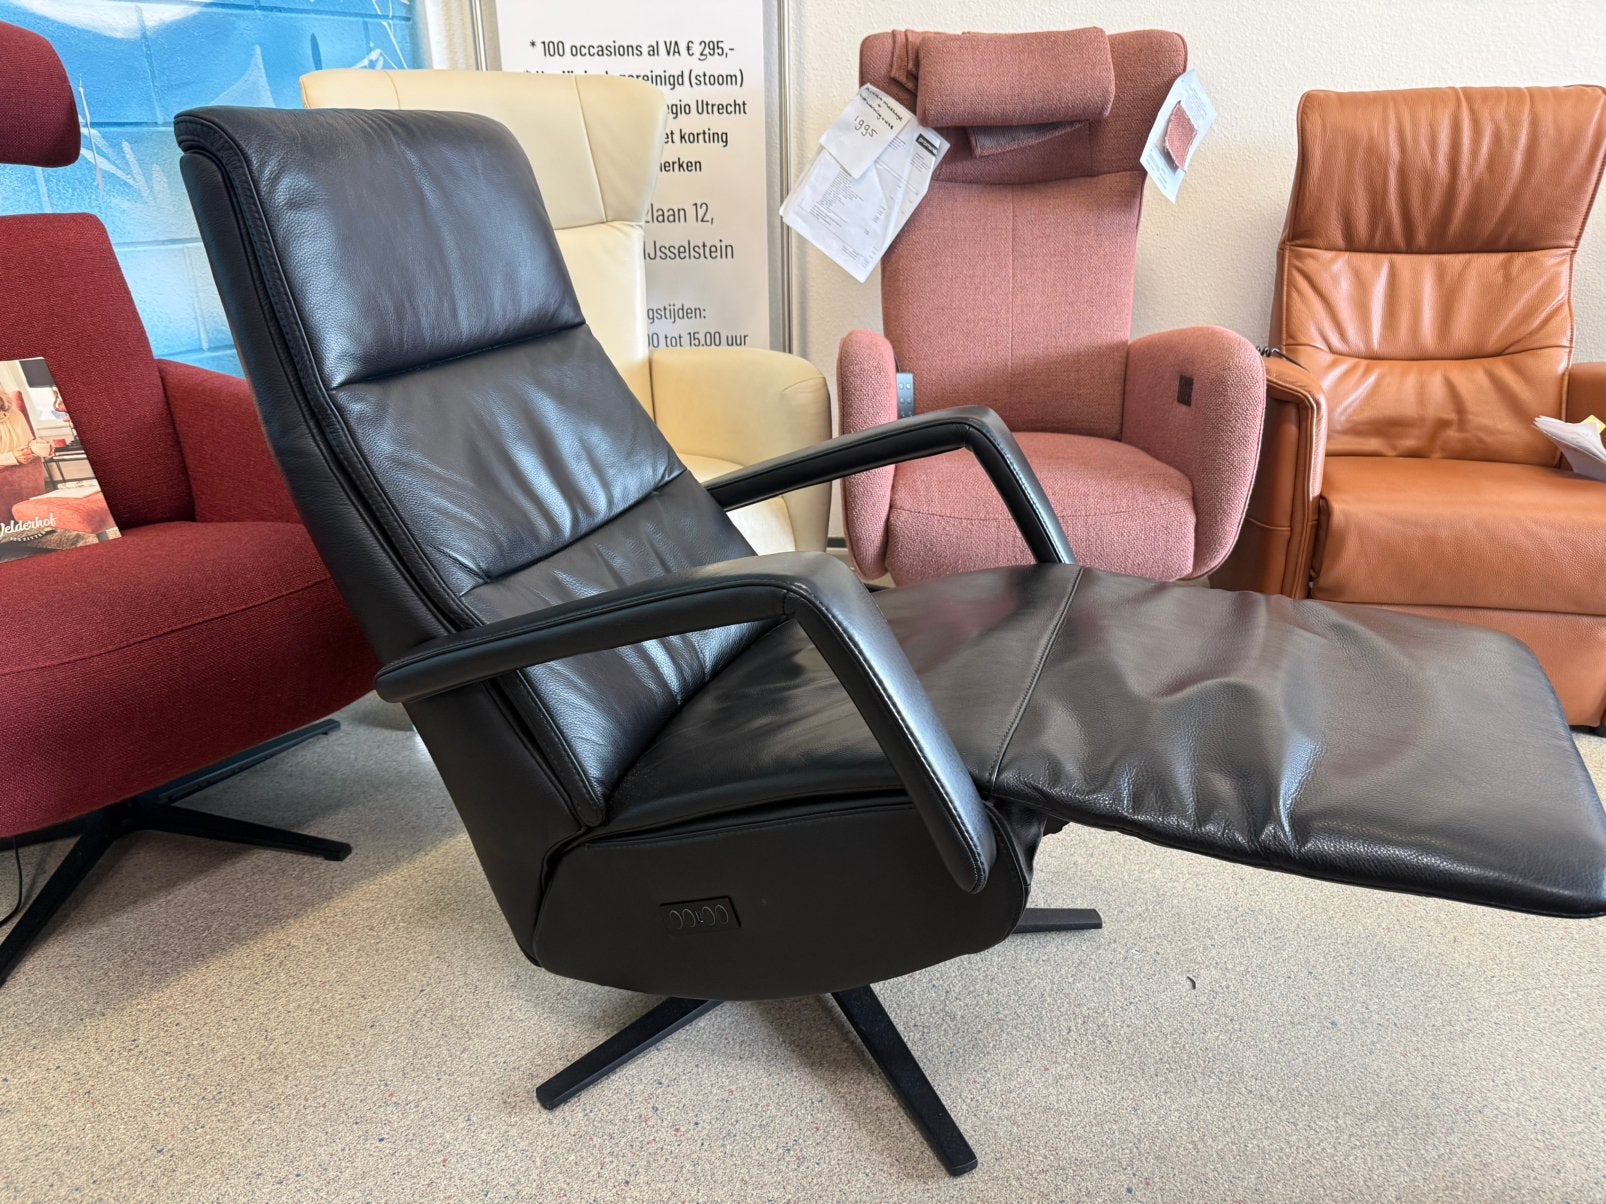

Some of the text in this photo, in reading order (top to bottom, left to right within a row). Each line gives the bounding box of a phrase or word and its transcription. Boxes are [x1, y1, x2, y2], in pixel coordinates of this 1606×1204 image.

[541, 40, 735, 61] 100 occasions al VA € 295,-
[619, 69, 744, 90] einigd (stoom)
[696, 99, 747, 115] Utrecht
[680, 128, 728, 148] korting
[660, 157, 702, 173] erken
[692, 202, 714, 225] 12,
[664, 334, 683, 348] tot
[687, 331, 722, 347] 15.00
[726, 334, 749, 347] uur
